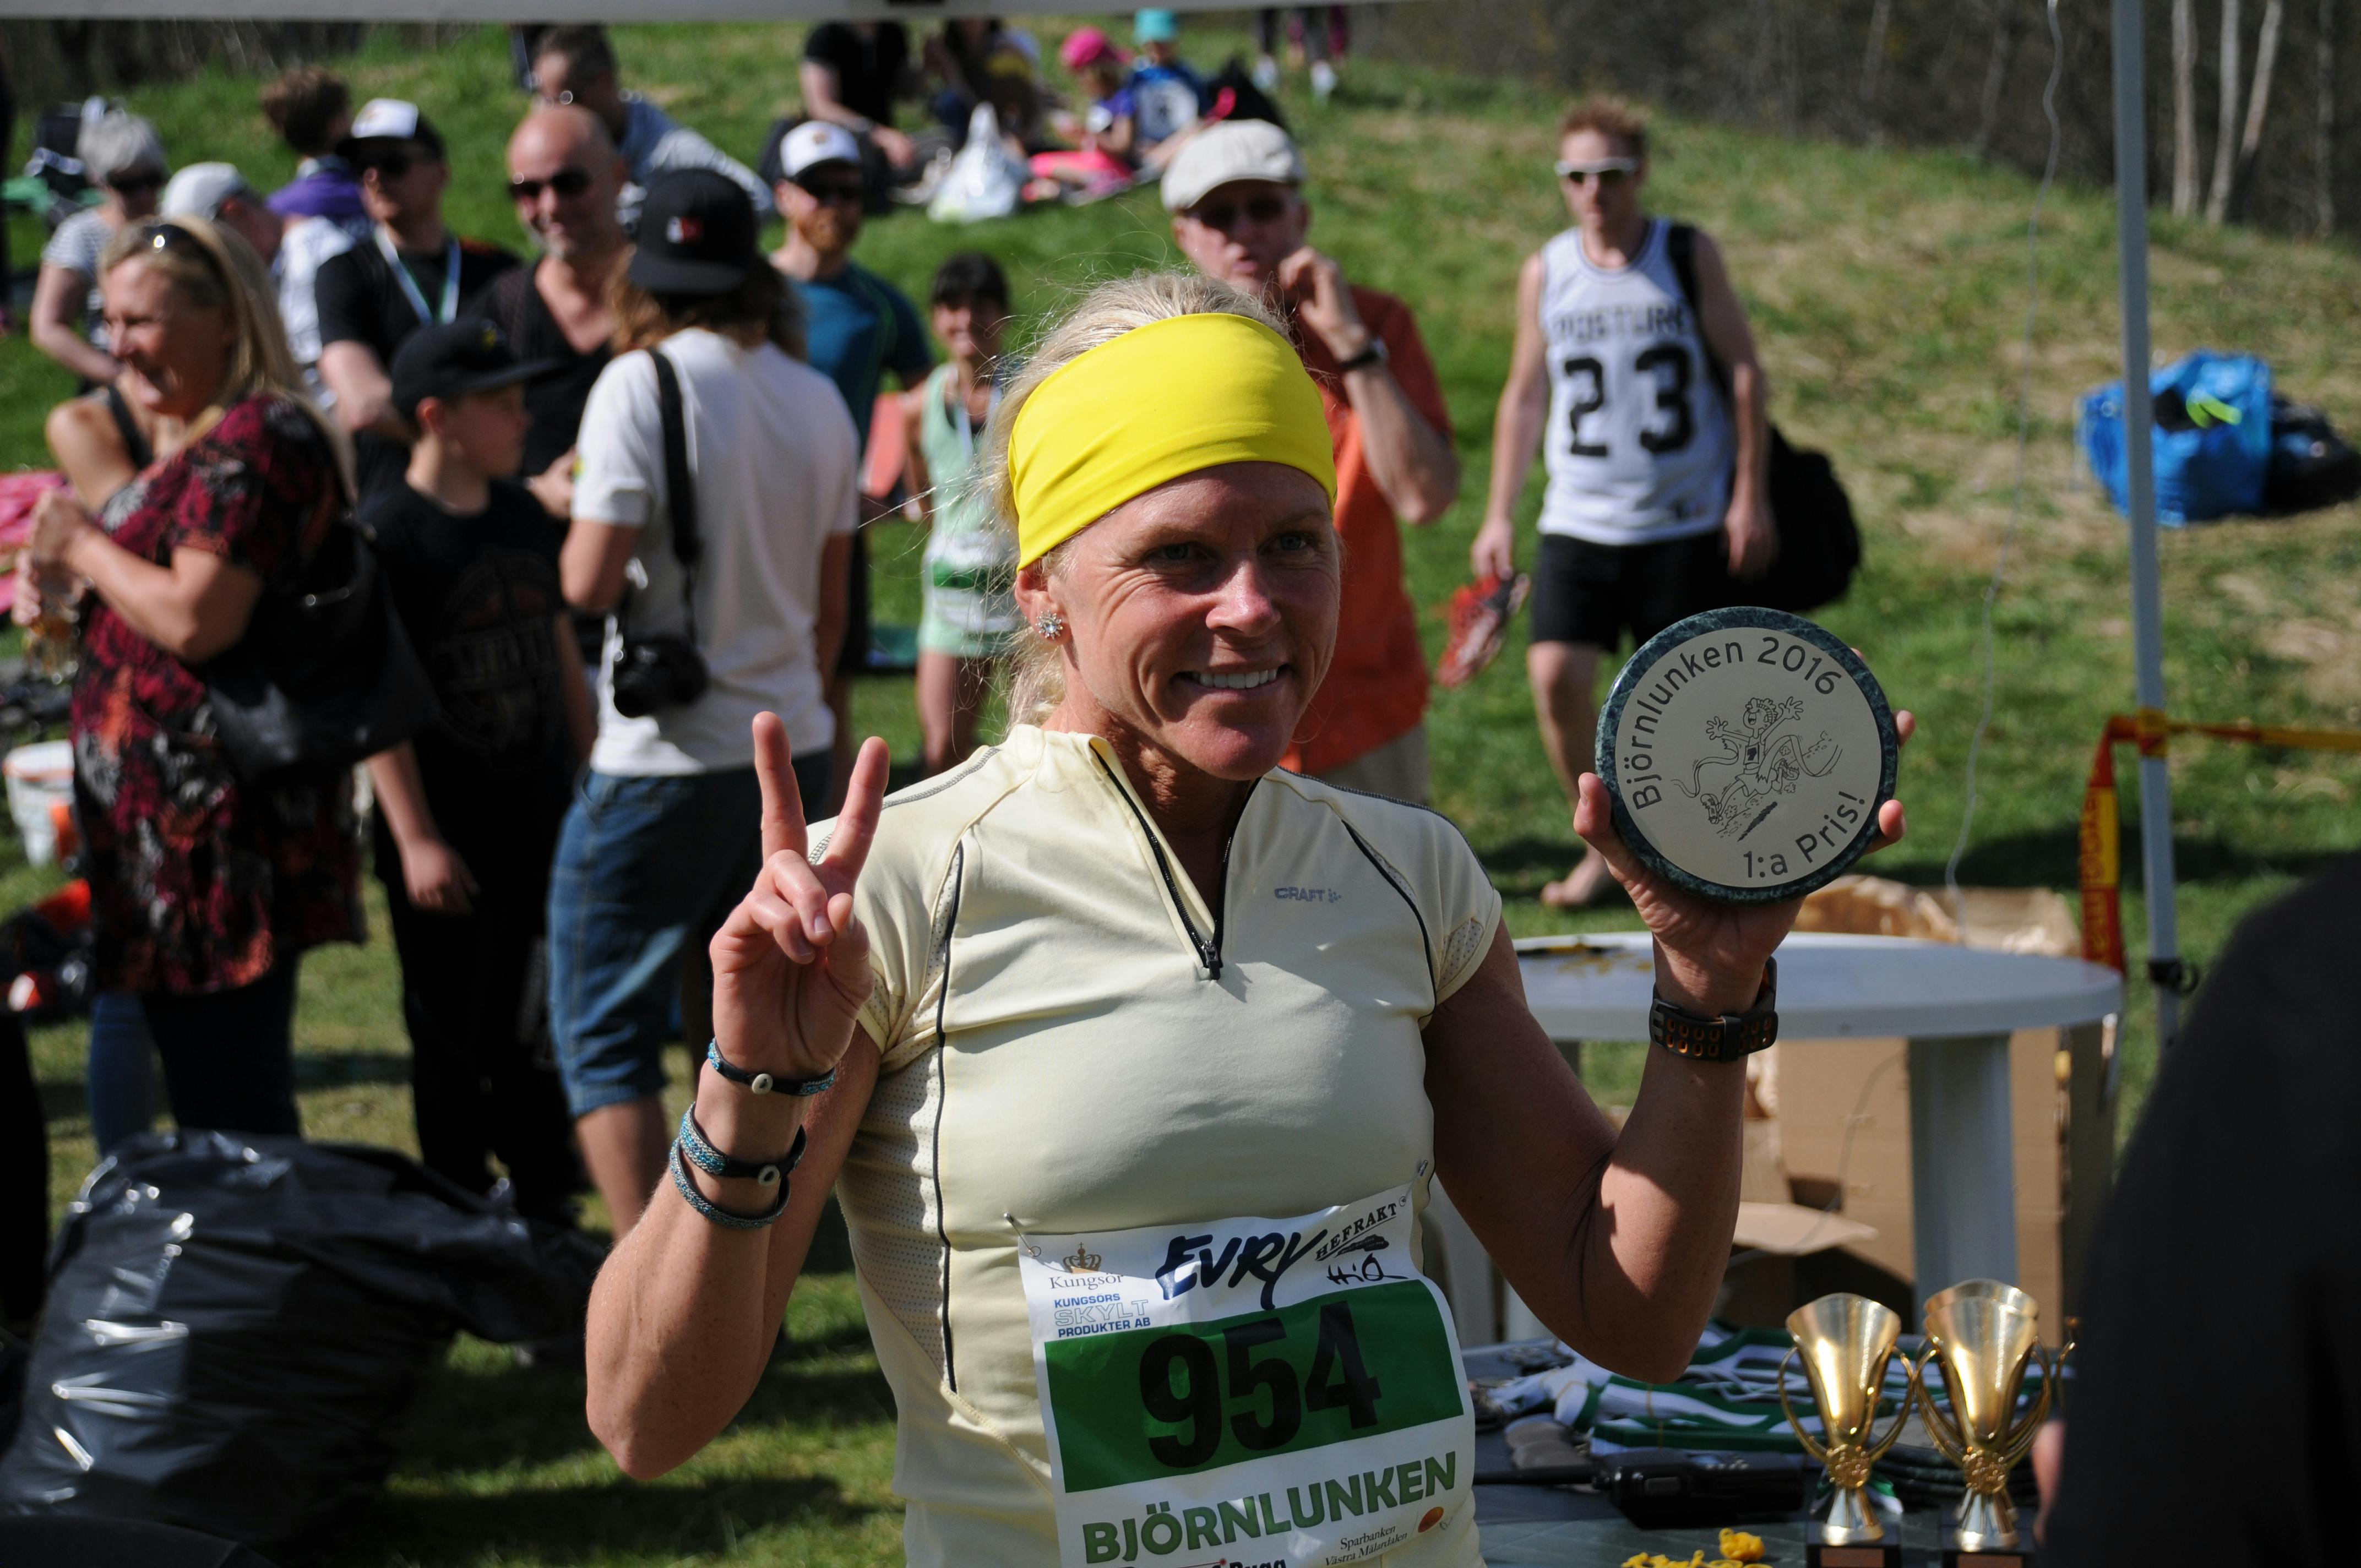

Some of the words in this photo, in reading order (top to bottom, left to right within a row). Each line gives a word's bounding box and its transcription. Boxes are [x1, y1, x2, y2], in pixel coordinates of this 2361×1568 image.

[1564, 344, 1693, 456] 23
[1624, 641, 1744, 810] Björnlunken
[1757, 636, 1842, 695] 2016
[1743, 851, 1788, 878] 1:a
[1795, 791, 1865, 863] Pris!
[1274, 886, 1325, 902] CRAFT
[1314, 1202, 1397, 1261] HEFRAKT
[1048, 1272, 1124, 1290] Kungsör
[1155, 1230, 1328, 1310] EVRY
[1054, 1293, 1121, 1308] KUNGSÖRS
[1054, 1299, 1149, 1327] SKYLT
[1058, 1321, 1131, 1338] PRODUKTER
[1134, 1317, 1151, 1328] AB
[1139, 1299, 1383, 1469] 954
[1082, 1450, 1457, 1565] BJÖRNLUNKEN
[1325, 1553, 1356, 1566] Västra
[1358, 1532, 1408, 1559] Mälardalen
[1340, 1525, 1396, 1551] Sparbanken
